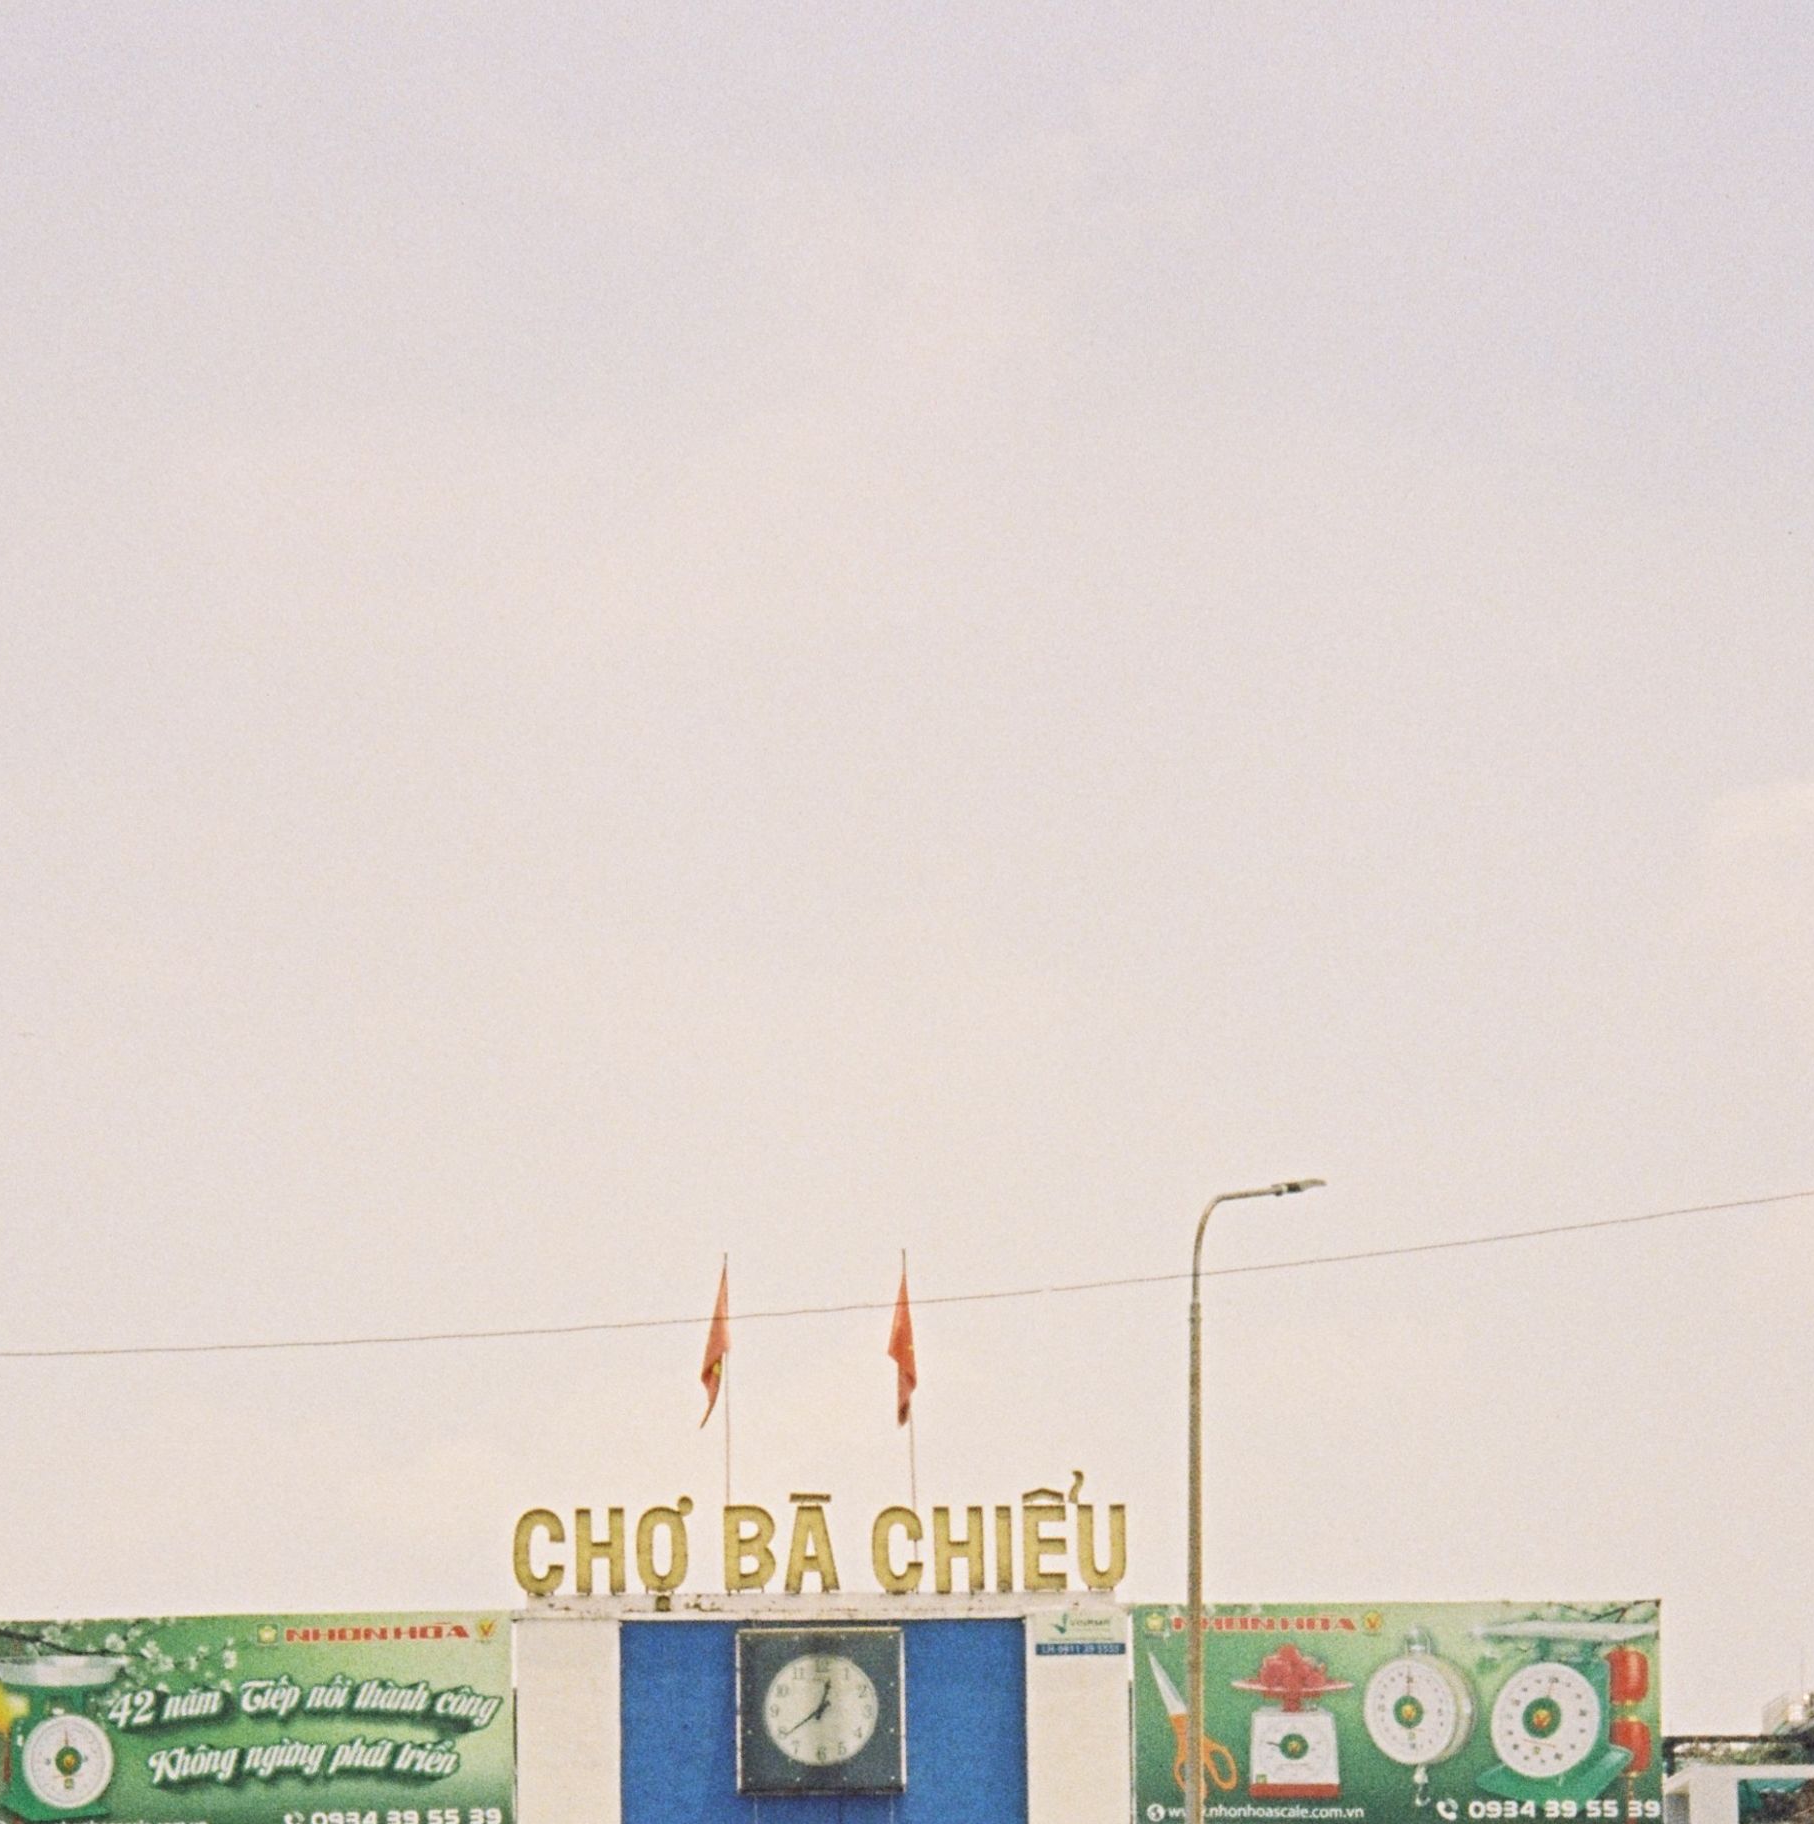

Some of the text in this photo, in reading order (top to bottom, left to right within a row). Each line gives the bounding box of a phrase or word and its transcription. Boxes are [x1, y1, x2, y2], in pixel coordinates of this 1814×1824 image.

[512, 1495, 694, 1611] CHỢ
[872, 1471, 1127, 1594] CHIỂU
[107, 1690, 156, 1728] 42
[162, 1687, 222, 1720] năm
[240, 1674, 301, 1717] Tiếp
[148, 1743, 239, 1785] Không
[1468, 1799, 1661, 1818] 0934 39 55 39
